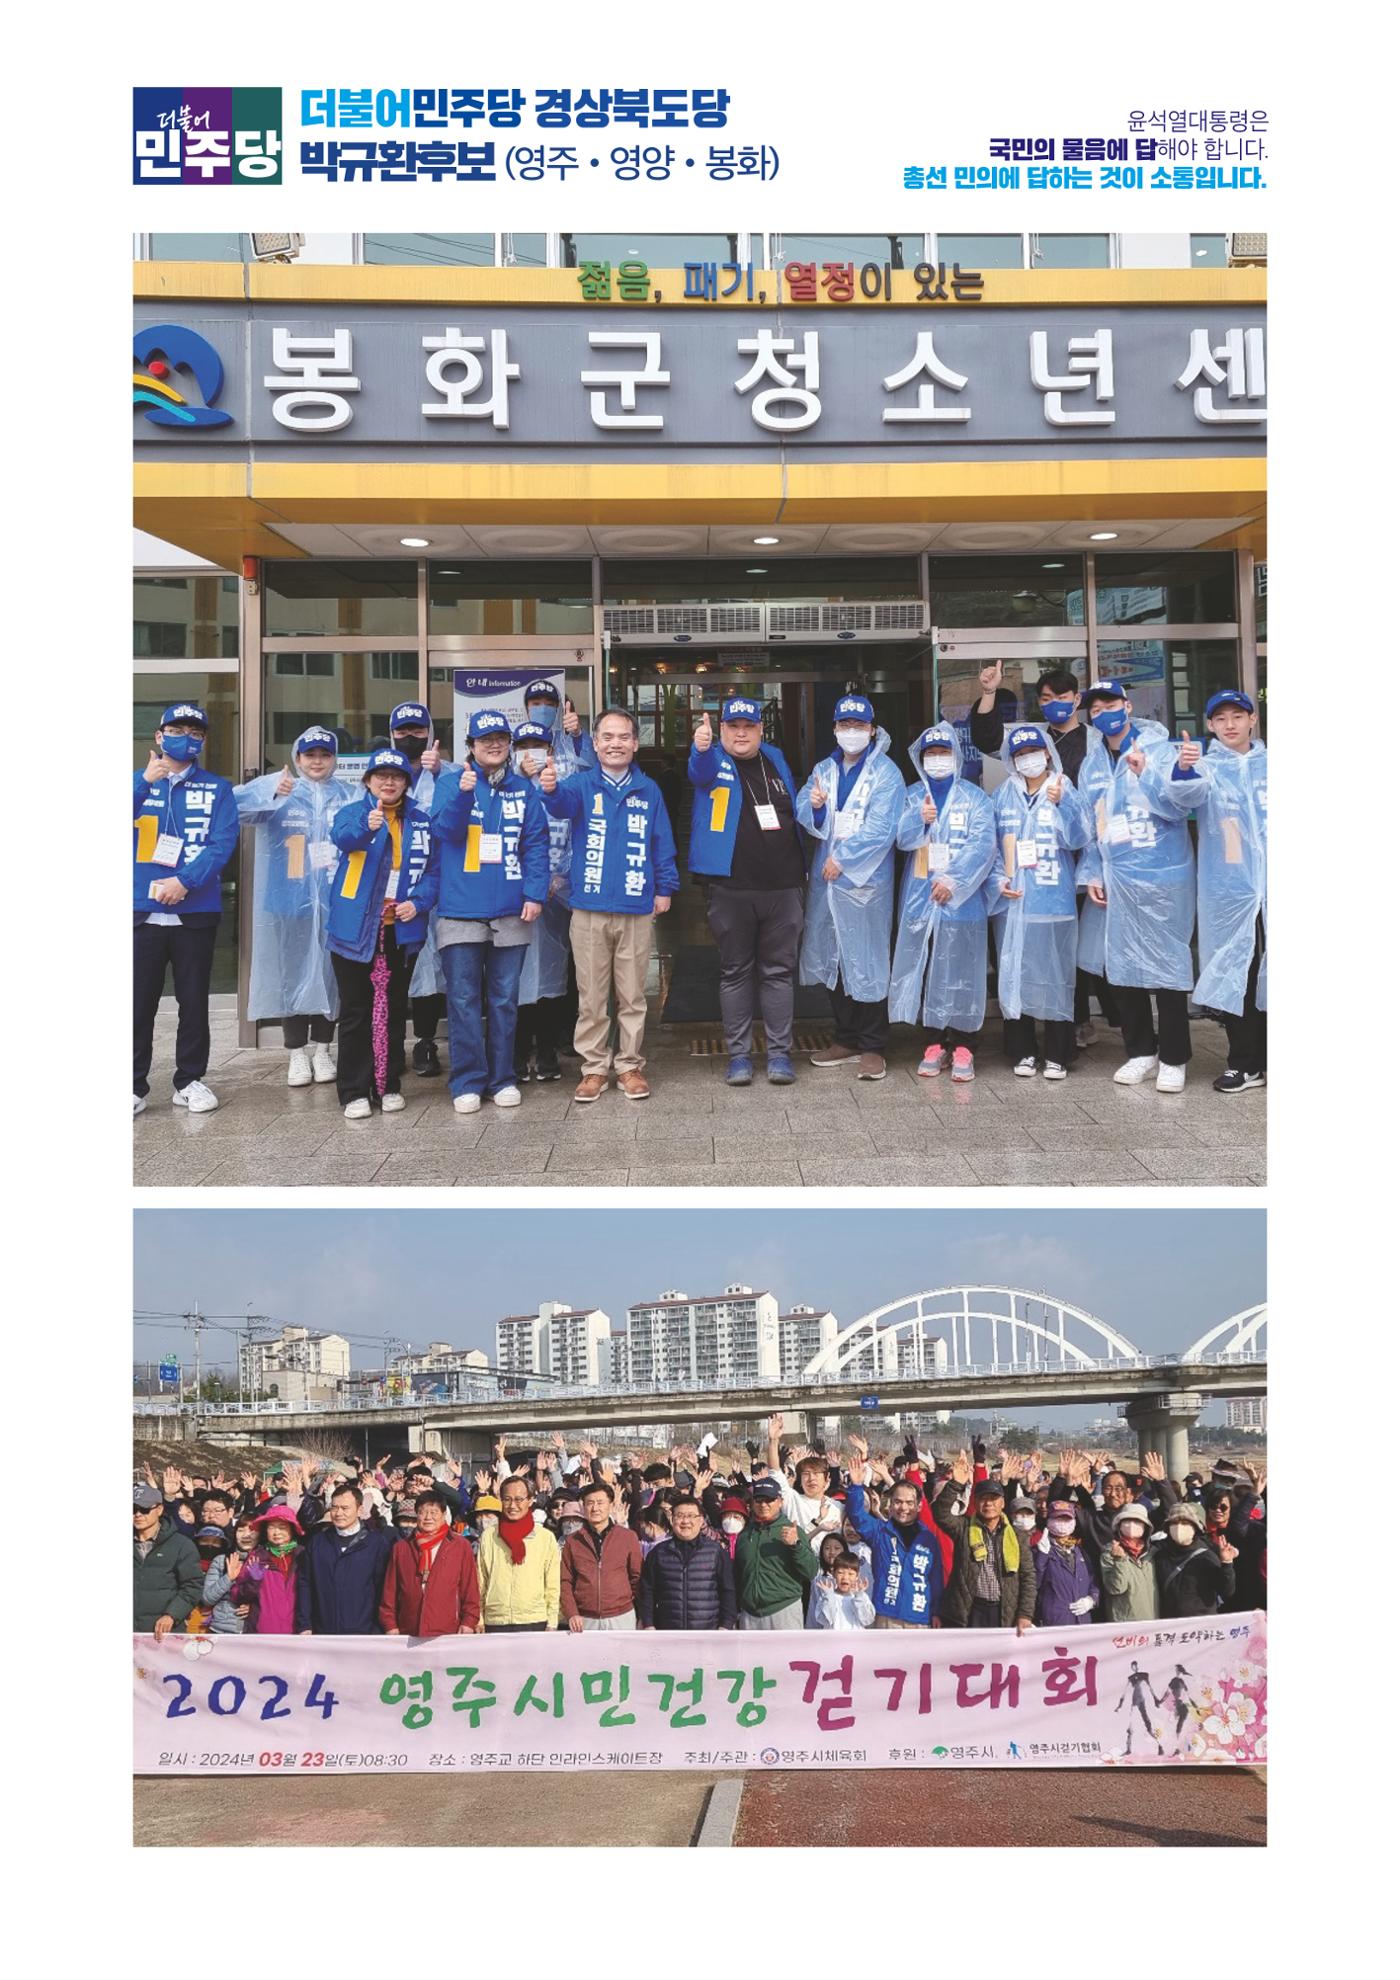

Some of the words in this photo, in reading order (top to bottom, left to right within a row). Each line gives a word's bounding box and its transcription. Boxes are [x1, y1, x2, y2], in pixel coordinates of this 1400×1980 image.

[577, 260, 662, 303] 젊음,
[684, 262, 766, 303] 패기,
[784, 261, 892, 301] 열정이
[914, 262, 984, 301] 있는
[592, 792, 604, 816] 1
[709, 786, 731, 833] 1
[134, 814, 159, 864] 1
[284, 834, 306, 879] 1
[408, 830, 430, 897] 박규
[502, 799, 526, 881] 박규환
[625, 813, 648, 897] 박규환
[912, 1553, 929, 1613] 박규환
[163, 1673, 339, 1720] 2024
[789, 1646, 1098, 1731] 걷기대회
[158, 1752, 188, 1766] 일시
[200, 1753, 255, 1766] 2024년
[259, 1751, 297, 1766] 03월
[429, 1753, 456, 1766] 장소
[470, 1752, 512, 1766] 영주교
[518, 1752, 546, 1766] 하단
[549, 1751, 664, 1766] 인라인스케이트장
[684, 1750, 748, 1764] 주최/주관
[781, 1749, 867, 1762] 영주시체육회
[889, 1748, 917, 1761] 후원
